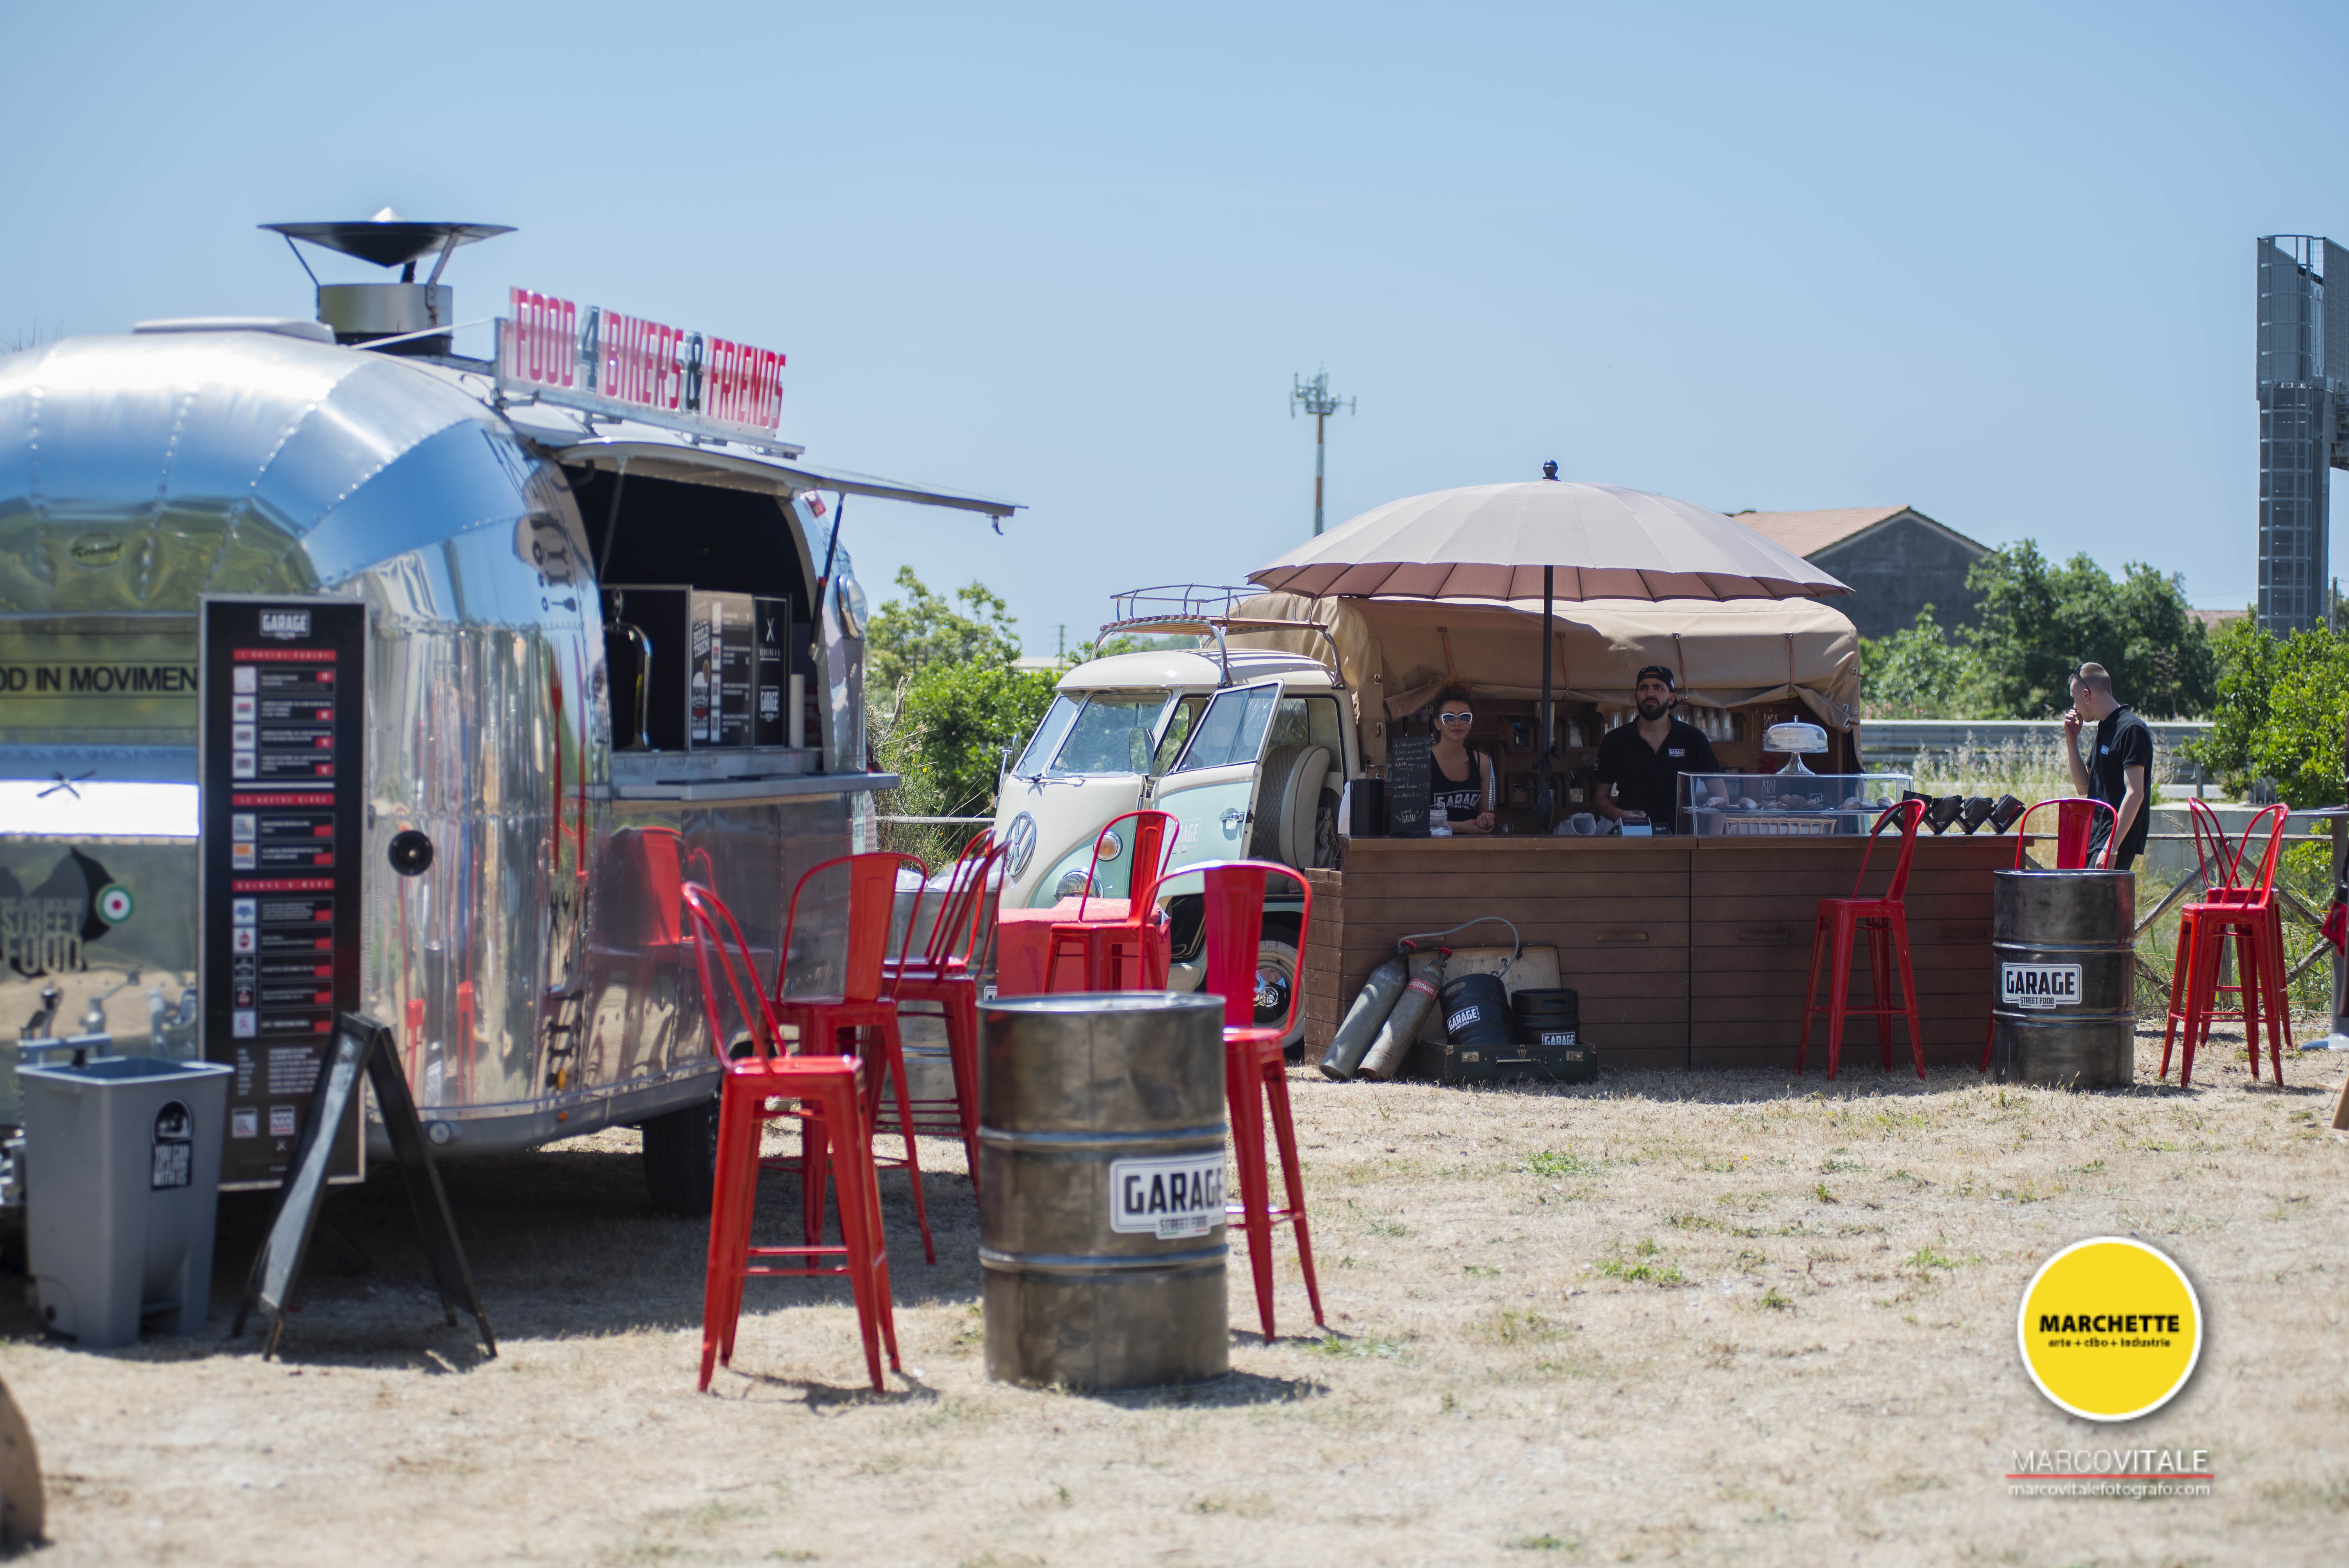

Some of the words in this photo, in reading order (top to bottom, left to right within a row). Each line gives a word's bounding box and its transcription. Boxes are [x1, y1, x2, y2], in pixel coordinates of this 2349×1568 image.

[508, 287, 575, 387] FOOD
[579, 306, 600, 391] 4
[601, 310, 683, 410] BIKERS
[685, 331, 704, 414] &
[707, 337, 786, 429] FRIENDS
[263, 615, 307, 632] GARAGE
[37, 667, 61, 691] IN
[71, 667, 198, 691] MOVIMEN
[761, 691, 778, 711] GARAGE
[1165, 823, 1200, 845] GRAGE
[2006, 971, 2075, 995] GARAGE
[1449, 1009, 1477, 1031] GARAGE
[1544, 1035, 1574, 1046] GARAGE
[1125, 1168, 1222, 1215] GARAGE
